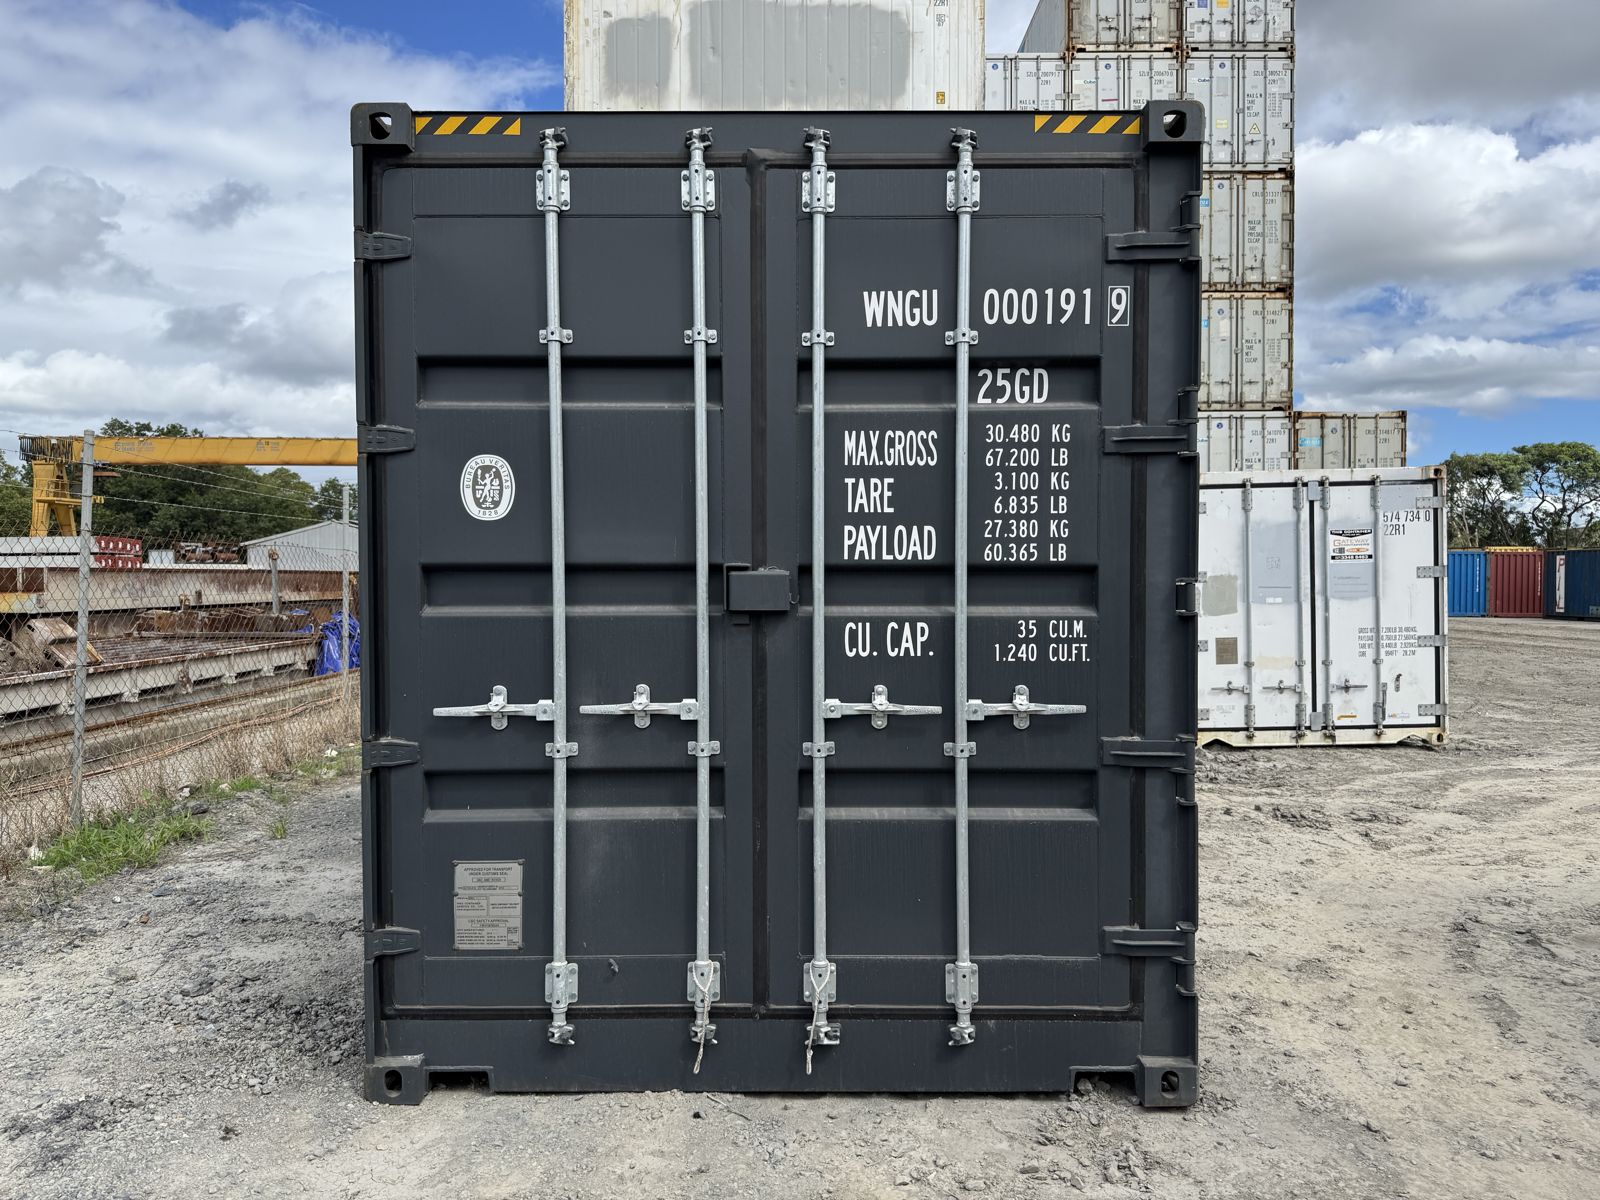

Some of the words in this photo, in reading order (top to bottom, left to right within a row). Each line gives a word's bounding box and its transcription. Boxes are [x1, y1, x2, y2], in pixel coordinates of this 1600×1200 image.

[863, 289, 938, 327] WNGU
[983, 288, 1091, 325] 000191
[1111, 289, 1127, 324] 9
[977, 368, 1049, 403] 25GD
[1051, 423, 1071, 443] KG
[844, 429, 938, 467] MAX.GROSS
[1051, 447, 1069, 467] LB
[465, 459, 486, 489] BUREAU
[489, 459, 510, 490] VERITAS
[1050, 471, 1070, 491] KG
[844, 477, 895, 513] TARE
[1050, 495, 1068, 514] LB
[1404, 510, 1420, 522] 734
[1049, 519, 1069, 538] KG
[1383, 524, 1406, 536] 22R1
[843, 525, 937, 560] PAYLOAD
[1049, 543, 1067, 562] LB
[1017, 619, 1037, 638] 35
[1049, 619, 1087, 638] CU.M.
[844, 621, 878, 658] CU.
[886, 621, 934, 658] CAP.
[1049, 643, 1091, 662] CU.FT.
